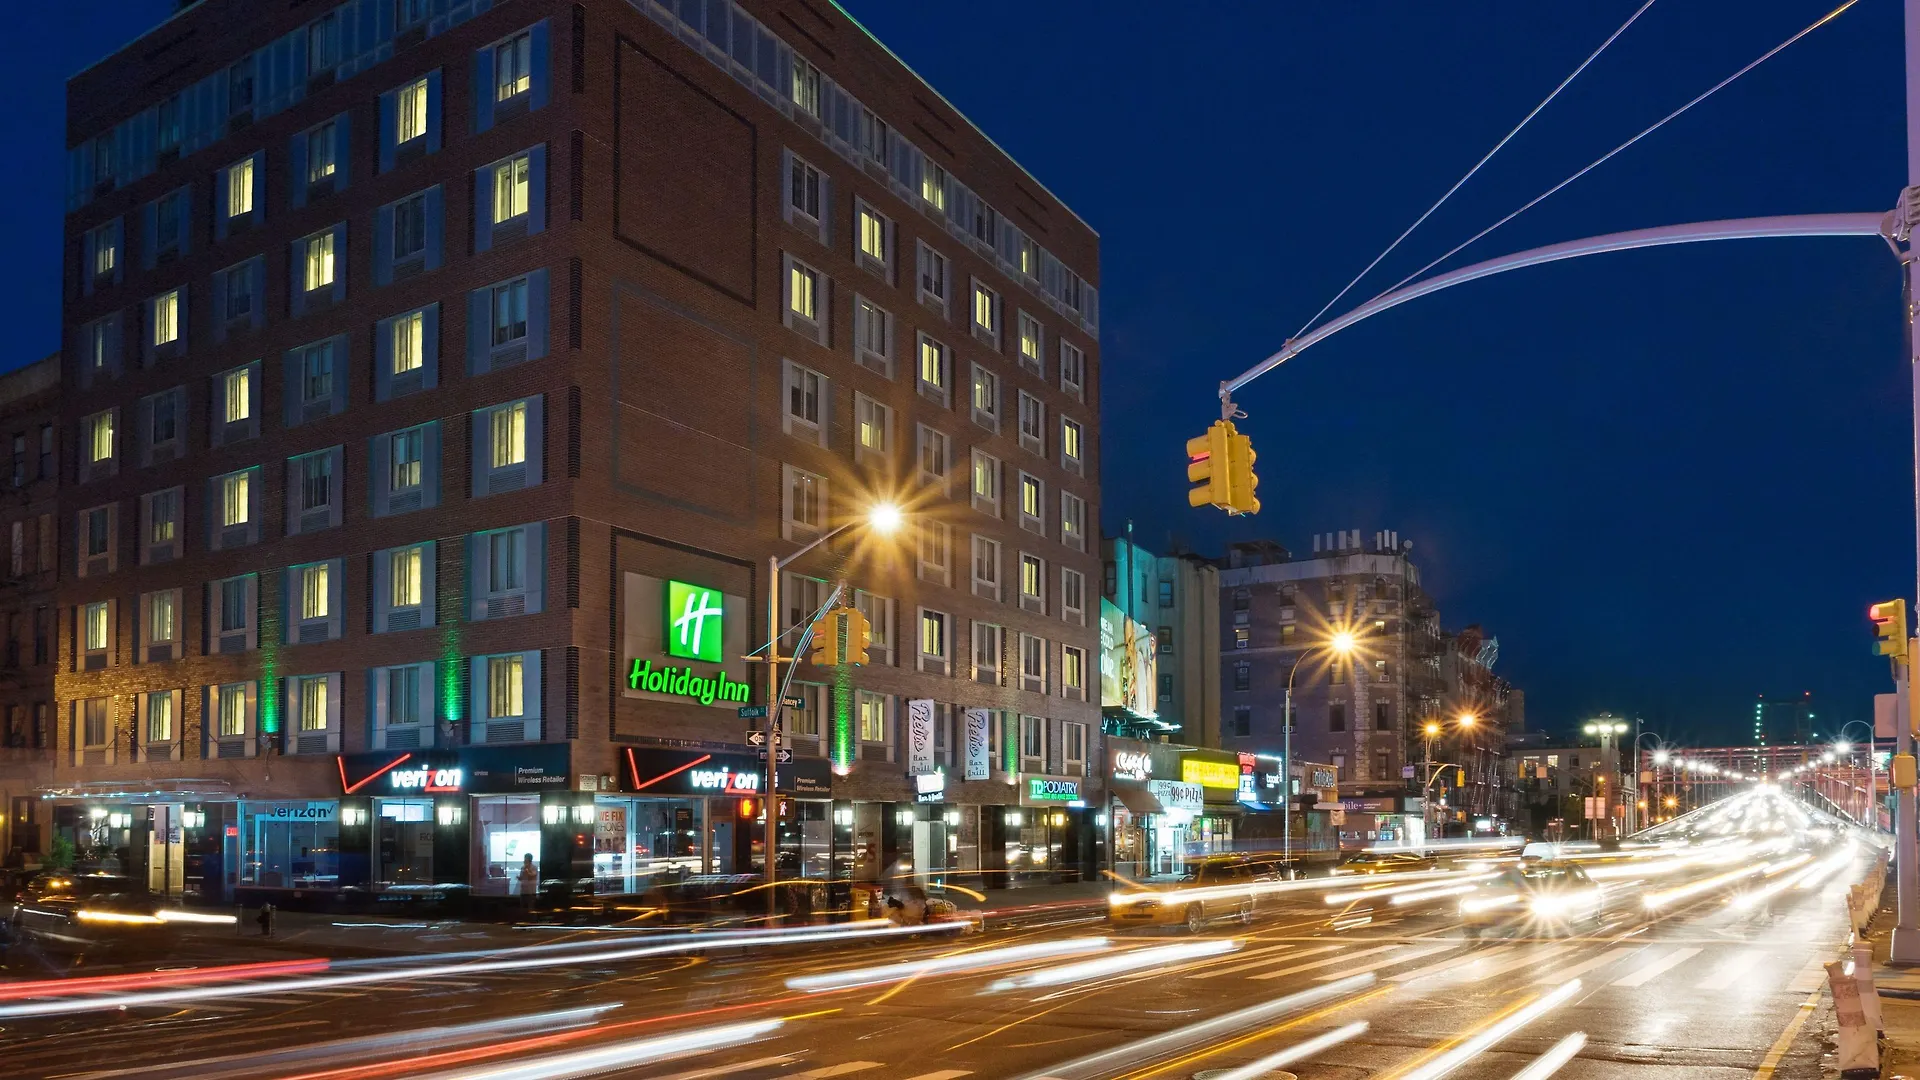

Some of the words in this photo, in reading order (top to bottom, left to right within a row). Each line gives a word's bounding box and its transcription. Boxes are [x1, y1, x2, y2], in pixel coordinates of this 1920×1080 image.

[630, 658, 716, 705] Holiday
[718, 671, 749, 702] Inn
[741, 708, 760, 717] Suffolk
[391, 764, 462, 792] verizon
[518, 776, 542, 784] Wireless
[691, 767, 759, 794] verizon
[1044, 781, 1078, 794] PODIATRY
[611, 811, 624, 821] FIX
[596, 822, 625, 831] PHONES
